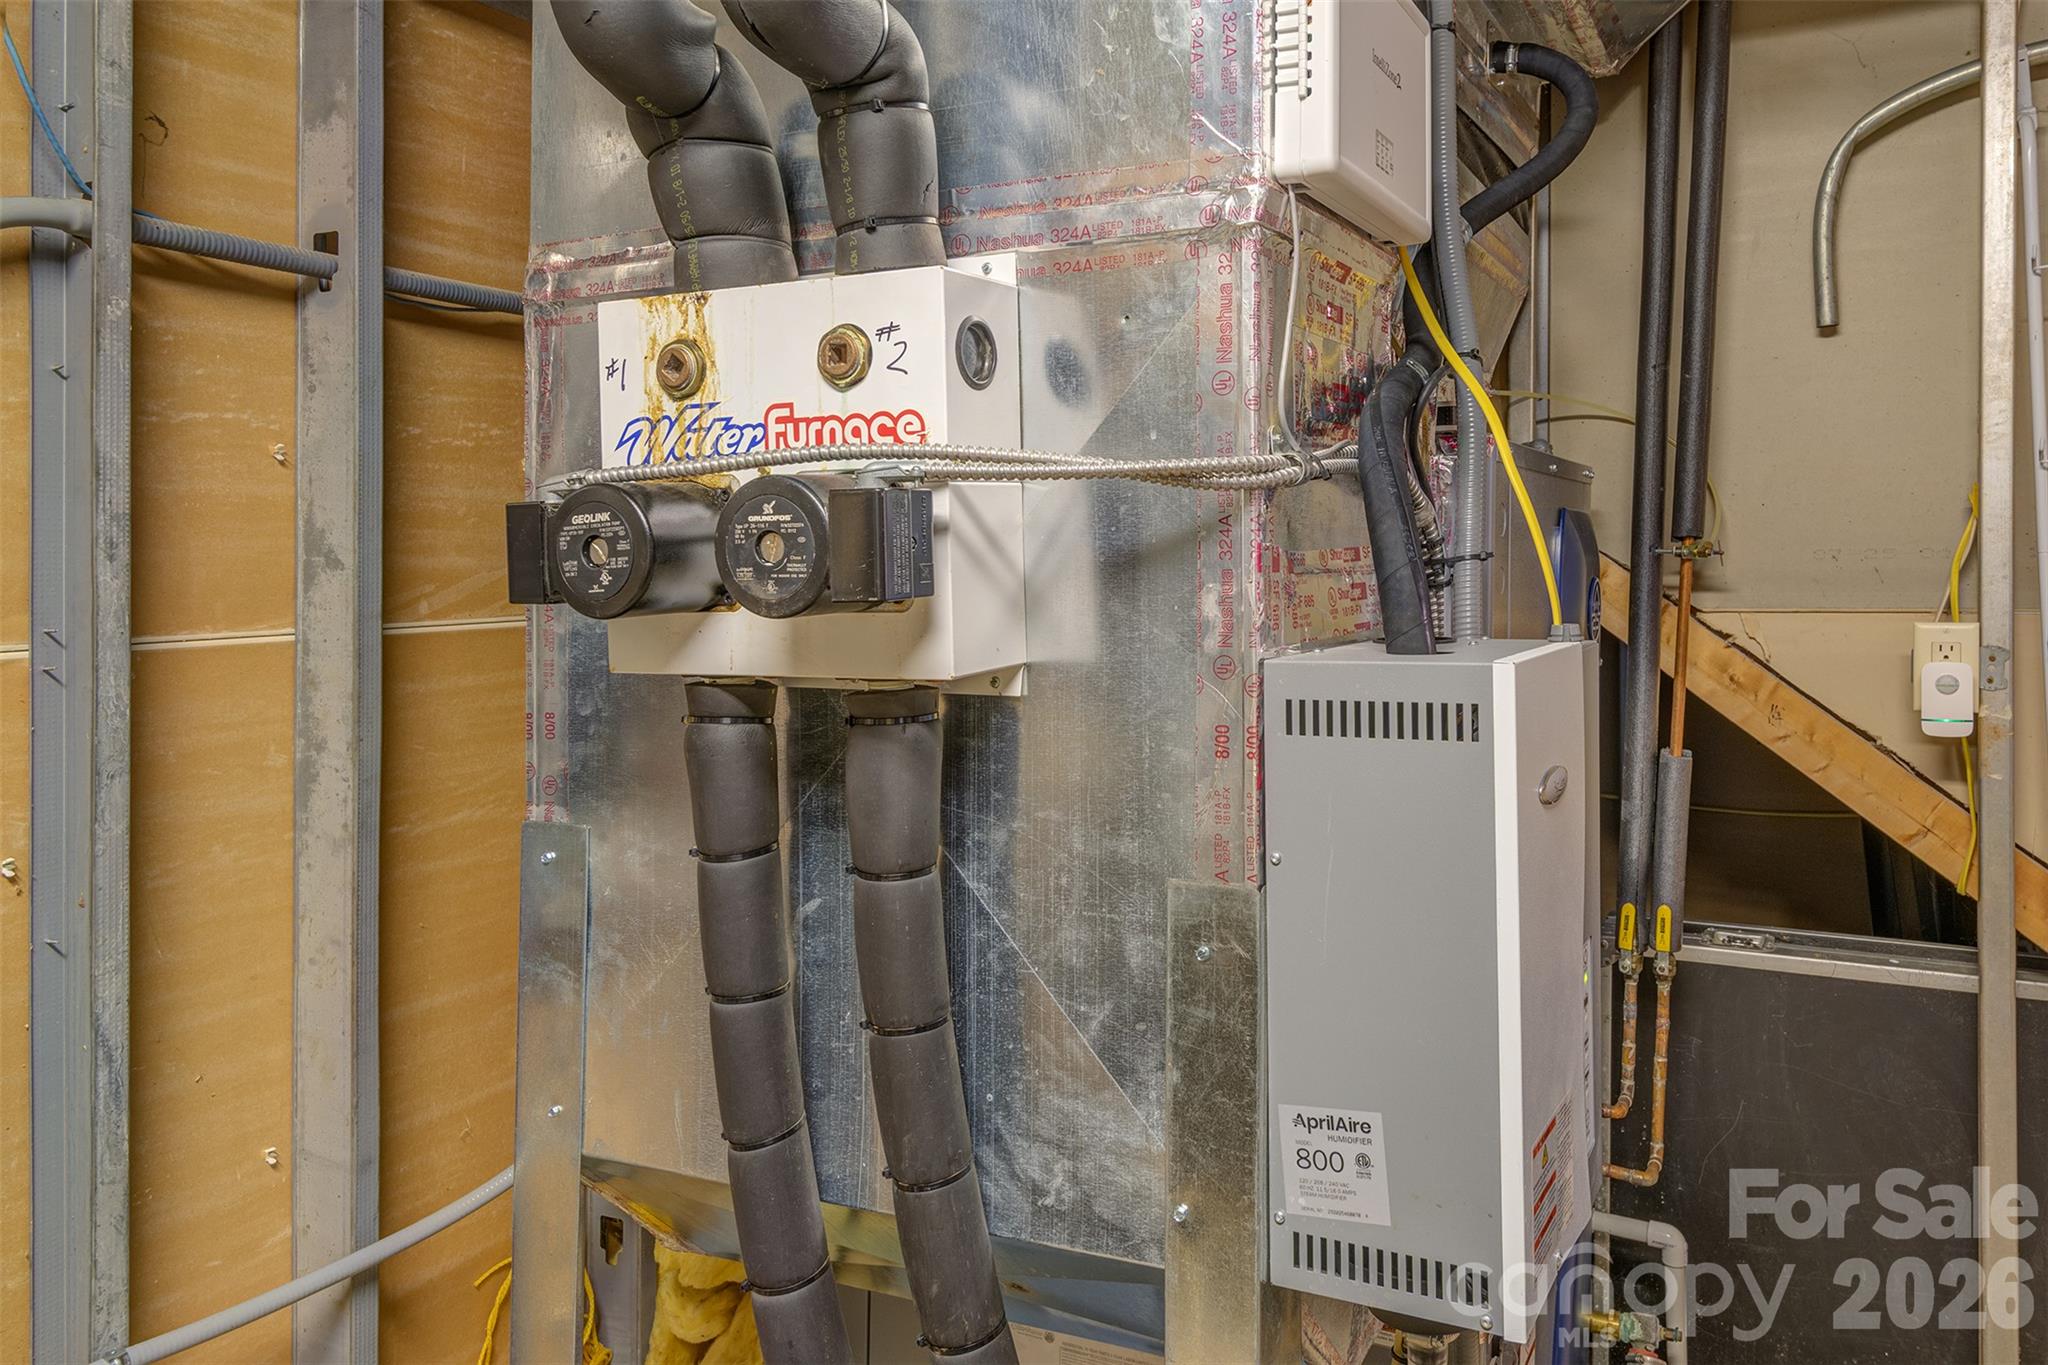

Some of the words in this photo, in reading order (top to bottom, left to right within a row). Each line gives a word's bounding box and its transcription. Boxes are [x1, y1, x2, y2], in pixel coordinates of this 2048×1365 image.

[1222, 11, 1237, 60] 324A
[1229, 61, 1237, 95] LISTED
[975, 231, 1044, 252] Nashua
[1050, 227, 1092, 244] 324A
[1091, 219, 1123, 232] LISTED
[1053, 258, 1093, 274] 324A
[586, 281, 615, 296] 324A
[1216, 282, 1233, 364] Nashua
[606, 358, 627, 391] #1
[572, 512, 611, 525] GEOLINK
[1218, 514, 1233, 561] 324A
[1218, 568, 1233, 648] Nashua
[544, 712, 555, 740] 8/00
[1215, 725, 1230, 759] 8/00
[1215, 790, 1223, 825] 181A-P
[1223, 787, 1231, 826] 181B-FX
[1215, 833, 1223, 869] LISTED
[1247, 835, 1255, 871] LISTED
[1292, 1113, 1372, 1134] AprilAire
[1327, 1135, 1373, 1146] HUMIDIFIER
[1296, 1148, 1344, 1173] 800
